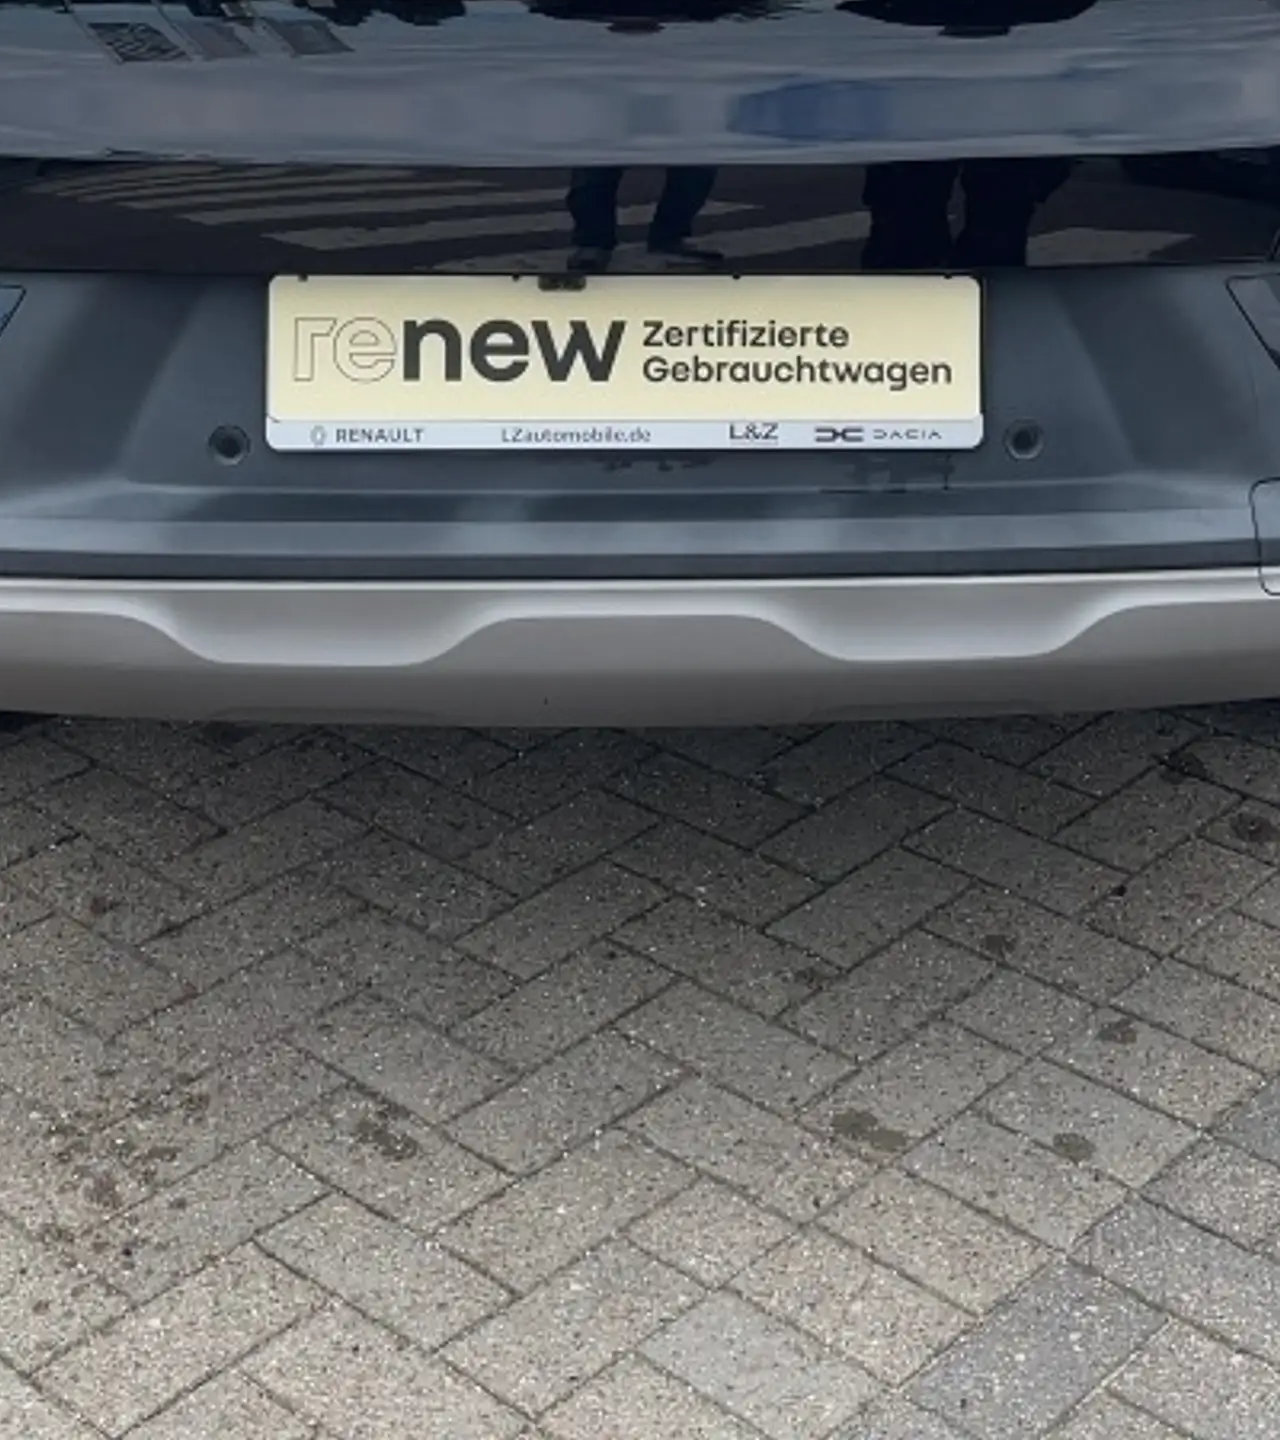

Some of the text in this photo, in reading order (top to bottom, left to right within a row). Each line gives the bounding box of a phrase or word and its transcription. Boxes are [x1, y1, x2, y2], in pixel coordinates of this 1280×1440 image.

[643, 319, 850, 348] Zertifizierte
[293, 317, 627, 383] renew
[643, 355, 952, 392] Gebrauchtwagen
[336, 428, 424, 443] RENAULT
[501, 426, 652, 444] LZautomobile.de
[729, 422, 780, 440] L&Z
[872, 429, 943, 440] DACIA
